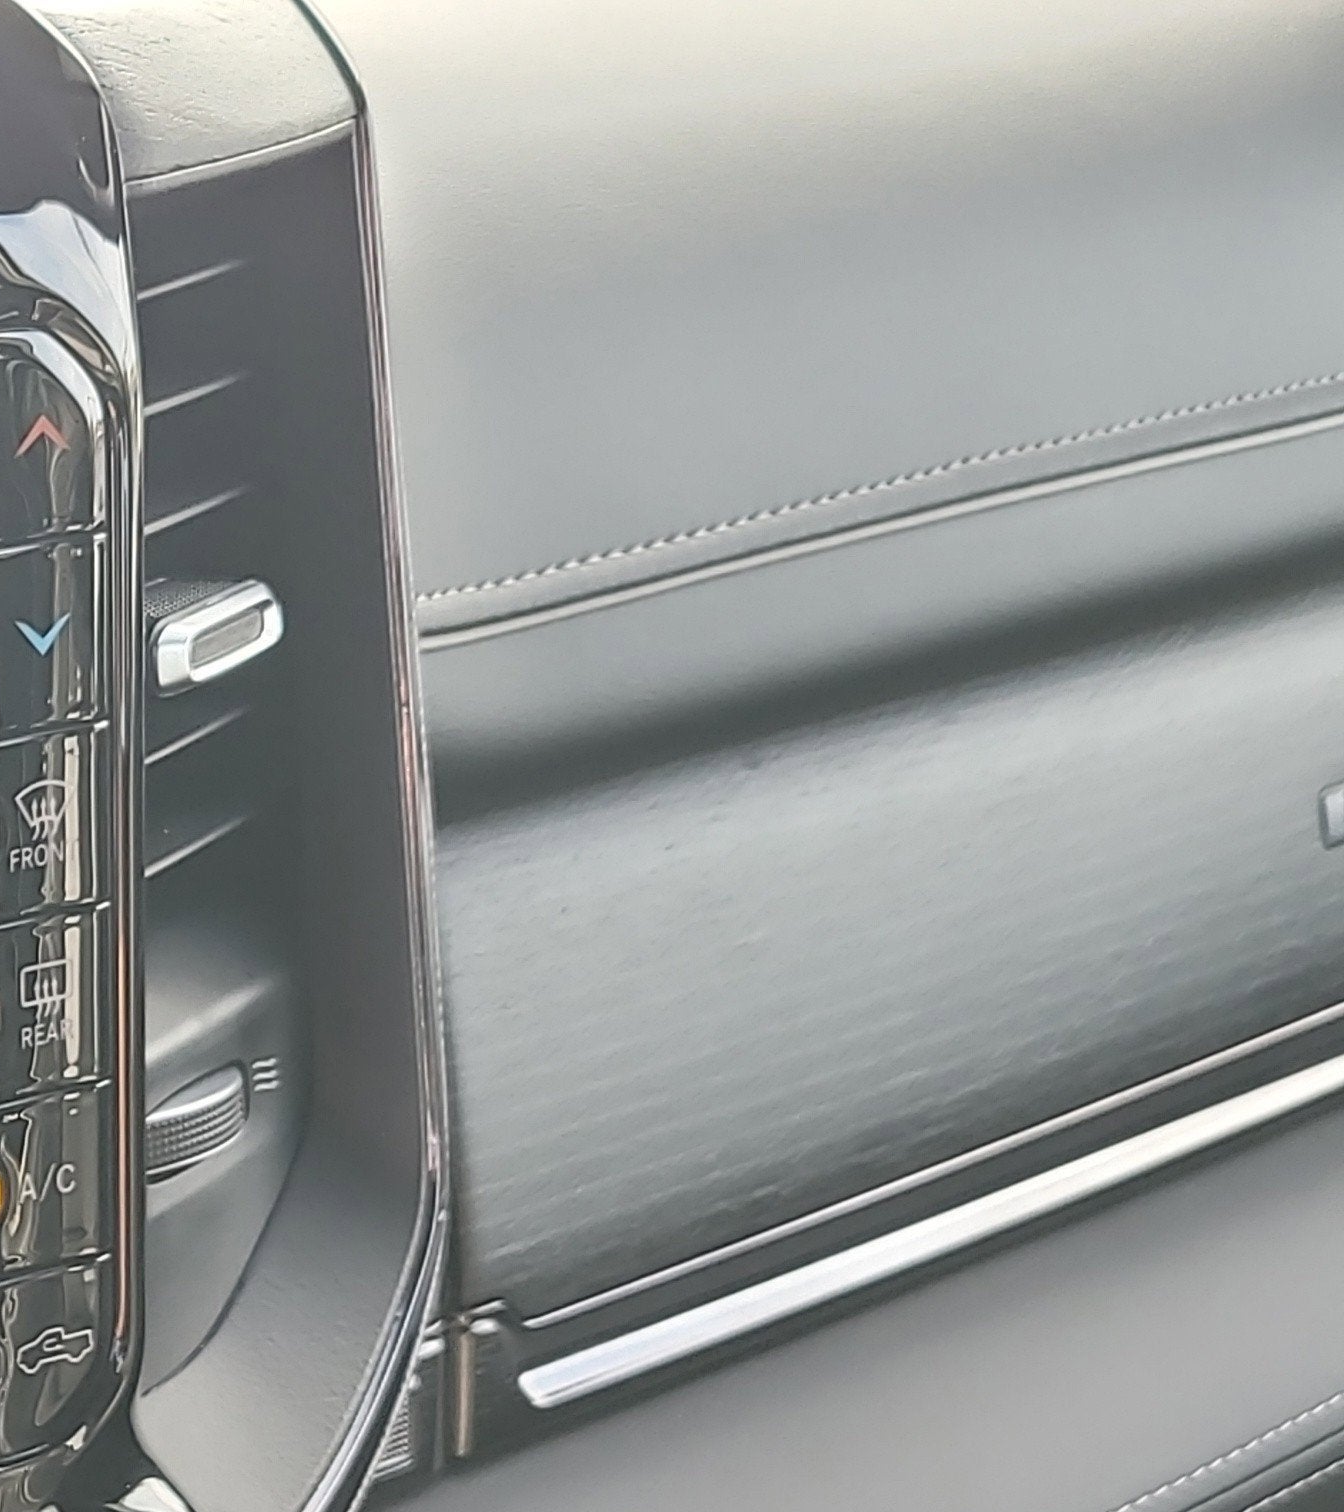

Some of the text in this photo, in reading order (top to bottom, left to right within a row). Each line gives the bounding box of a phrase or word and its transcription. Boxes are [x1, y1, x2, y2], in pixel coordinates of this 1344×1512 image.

[9, 840, 79, 873] FRON
[21, 1019, 74, 1051] REAR
[19, 1163, 77, 1204] A/C
